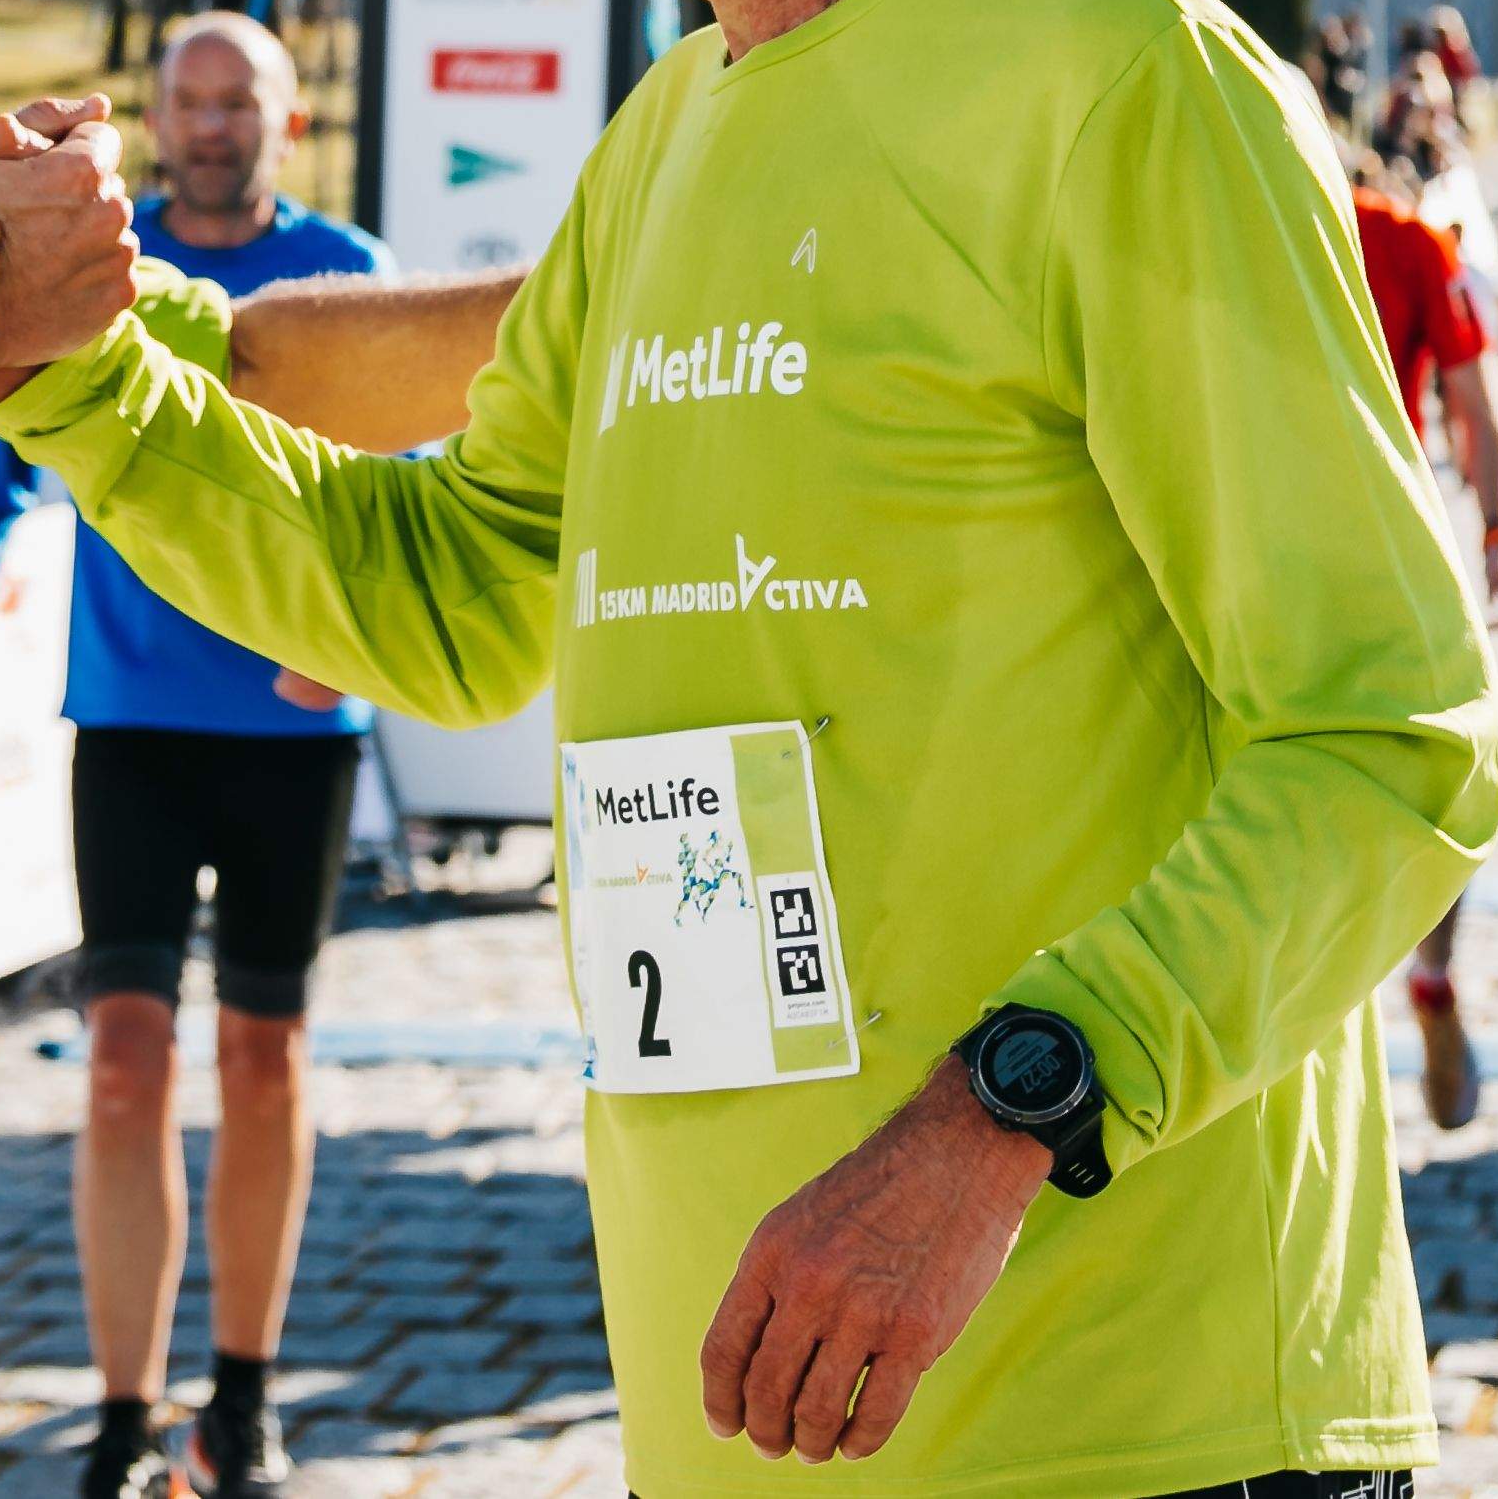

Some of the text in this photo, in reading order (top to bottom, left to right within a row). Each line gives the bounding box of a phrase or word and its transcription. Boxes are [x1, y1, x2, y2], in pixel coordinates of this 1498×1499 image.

[627, 322, 807, 407] MetLife
[599, 586, 647, 621] 15KM
[595, 778, 720, 826] MetLife
[627, 949, 672, 1058] 2
